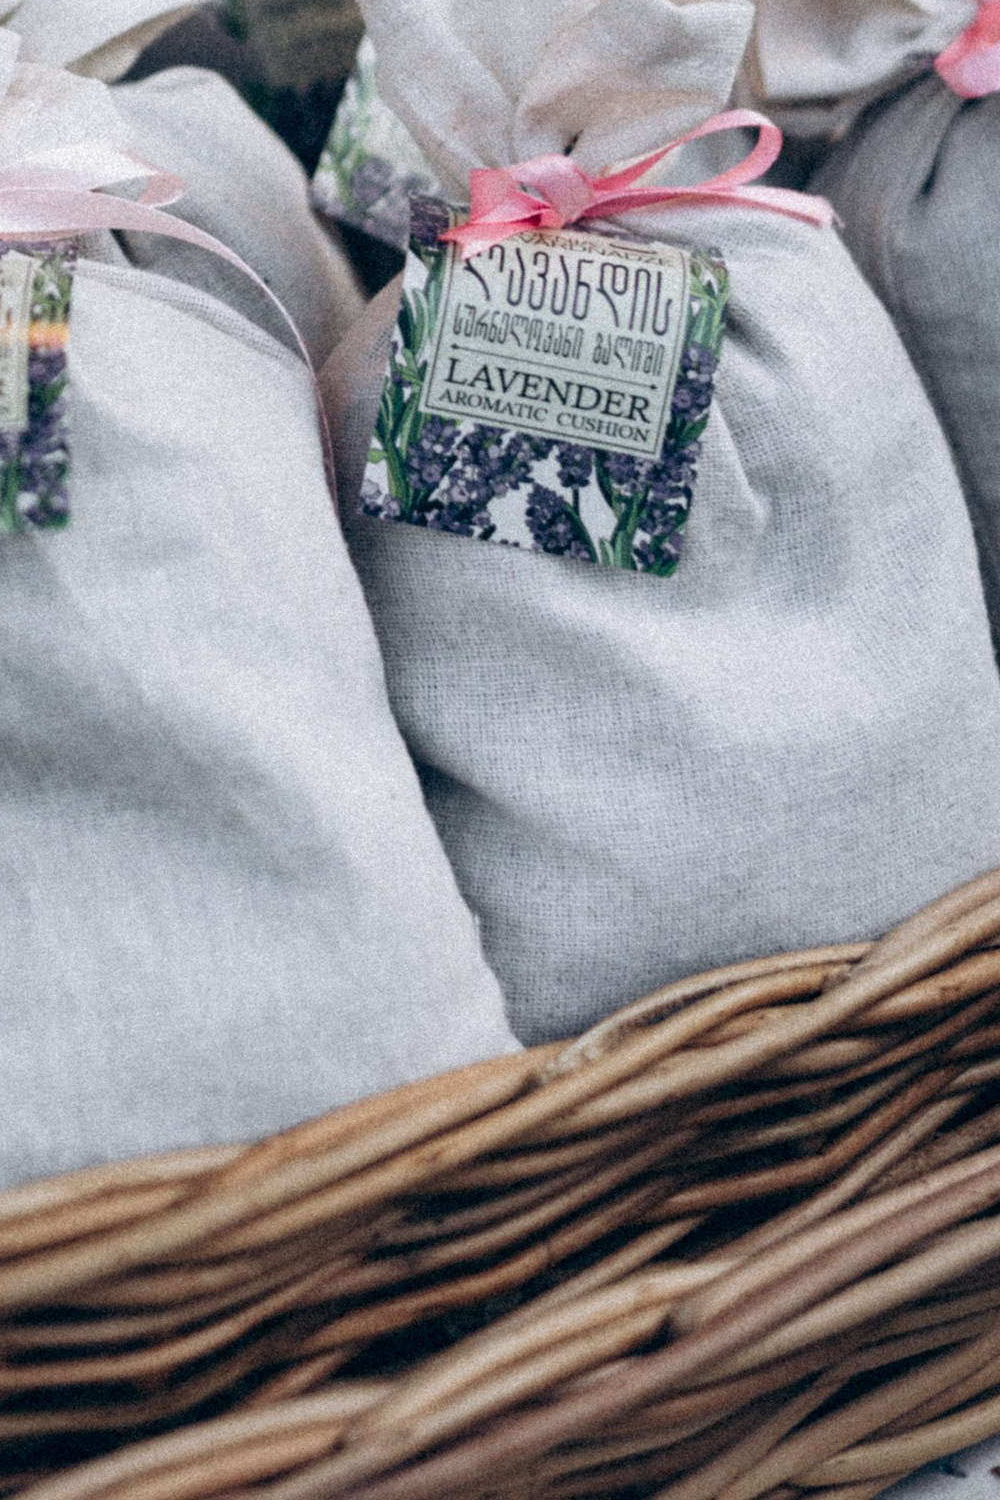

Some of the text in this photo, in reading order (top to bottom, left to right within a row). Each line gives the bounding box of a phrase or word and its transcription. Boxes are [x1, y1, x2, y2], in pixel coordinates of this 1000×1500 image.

[440, 388, 650, 444] AROMATIC CUSHION
[445, 357, 651, 424] LAVENDER
